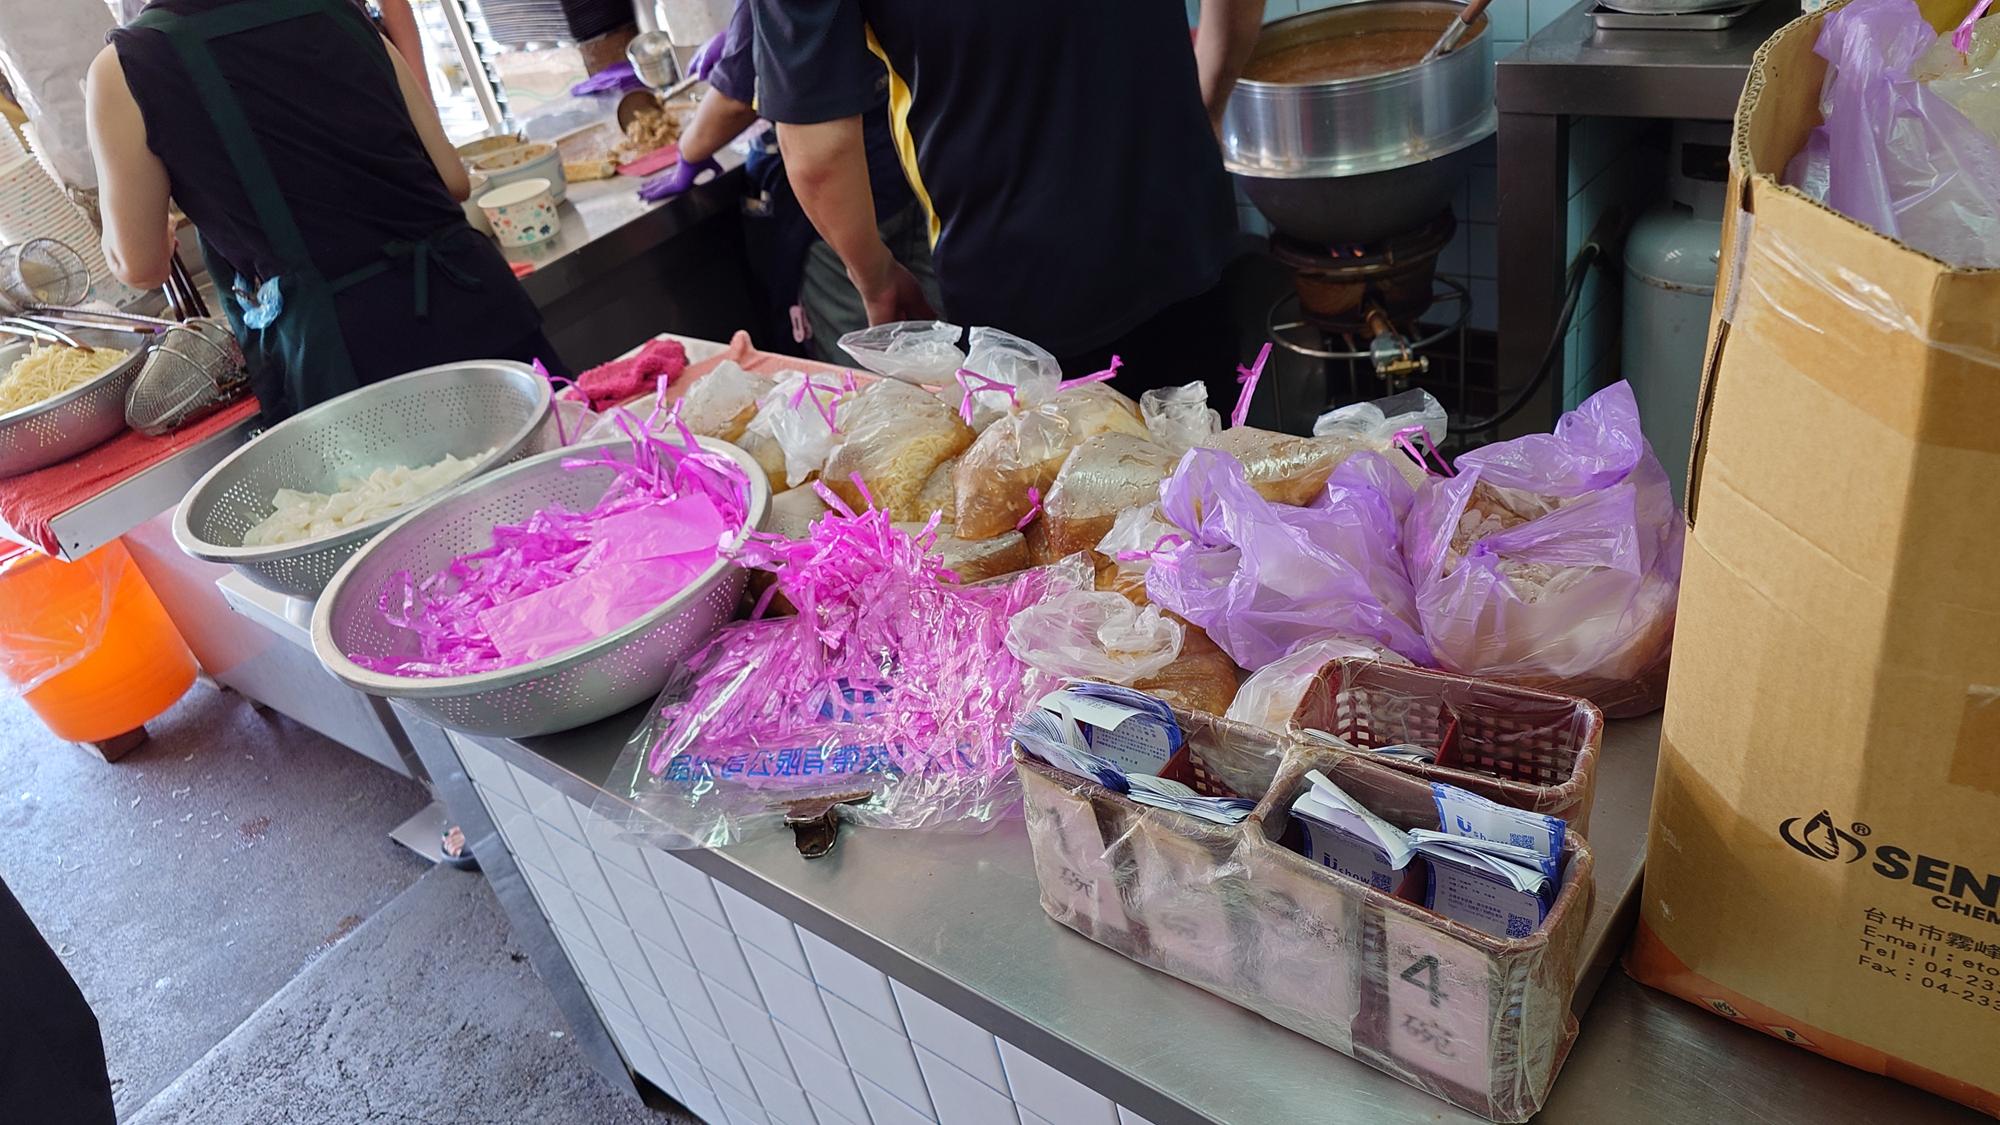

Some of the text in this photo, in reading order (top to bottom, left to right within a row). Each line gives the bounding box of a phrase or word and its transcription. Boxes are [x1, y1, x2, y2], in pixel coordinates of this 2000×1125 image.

[1872, 845, 2000, 908] SEN
[1864, 907, 2000, 959] 台中市霧峰
[1400, 955, 1449, 1008] 4
[1924, 961, 2000, 993] 04-23
